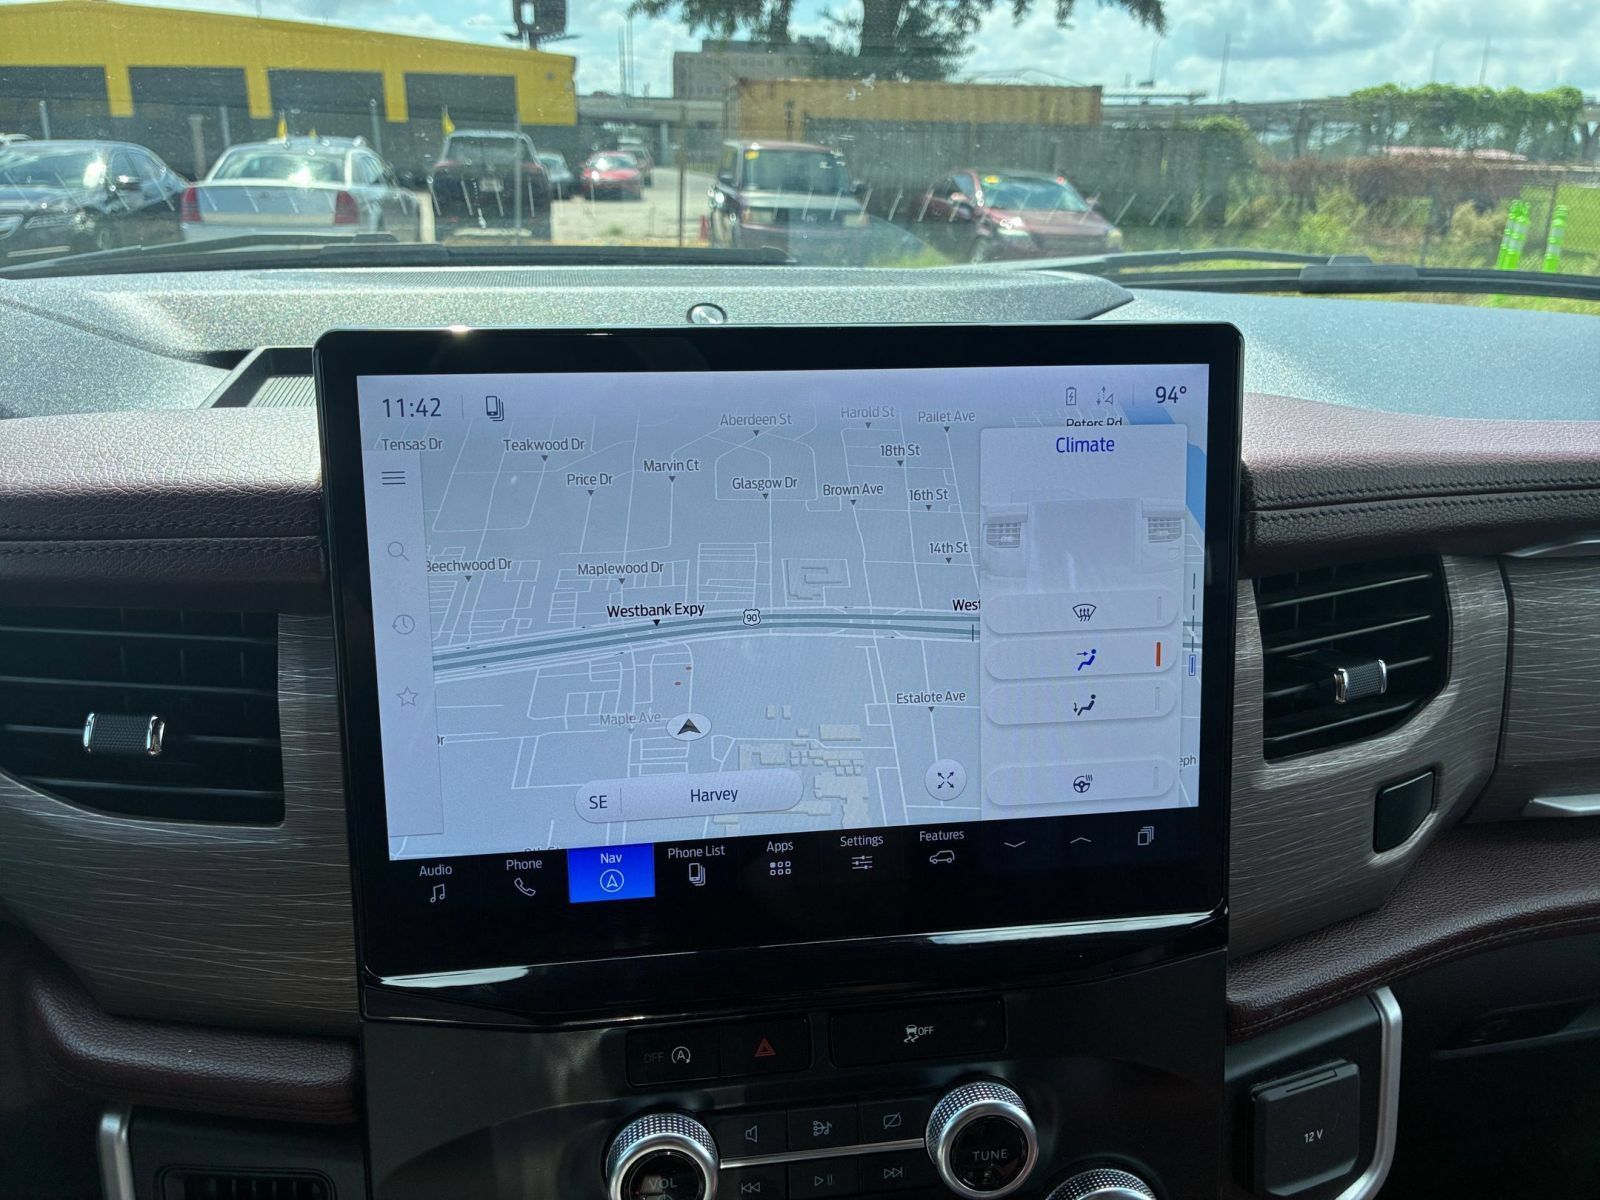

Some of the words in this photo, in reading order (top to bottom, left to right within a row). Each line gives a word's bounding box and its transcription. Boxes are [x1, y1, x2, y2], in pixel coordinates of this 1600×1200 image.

[381, 397, 442, 418] 11:42
[841, 406, 879, 419] Harold
[882, 406, 895, 418] St
[720, 412, 776, 426] Aberdeen
[779, 412, 792, 425] St
[918, 410, 951, 423] Pailet
[953, 410, 976, 422] Ave
[381, 438, 426, 451] Tensas
[428, 437, 443, 450] Dr
[503, 438, 568, 452] Teakwood
[571, 437, 585, 450] Dr
[880, 444, 904, 457] 18th
[907, 444, 920, 456] St
[1056, 437, 1115, 453] Climate
[643, 459, 683, 472] Marvin
[686, 459, 700, 471] Ct
[567, 473, 596, 486] Price
[599, 473, 613, 485] Dr
[732, 477, 782, 492] Glasgow
[784, 476, 798, 489] Dr
[823, 484, 859, 496] Brown
[861, 483, 884, 495] Ave
[909, 488, 933, 501] 16th
[935, 488, 949, 500] St
[929, 541, 953, 554] 14th
[955, 541, 969, 553] St
[426, 558, 496, 573] Beechwood
[498, 558, 512, 570] Dr
[577, 562, 649, 577] Maplewood
[650, 561, 665, 573] Dr
[606, 603, 671, 618] Westbank
[674, 603, 705, 618] Expy
[746, 613, 758, 622] 90
[896, 691, 943, 704] Estalote
[944, 690, 966, 703] Ave
[600, 713, 637, 727] Maple
[638, 711, 661, 724] Ave
[589, 794, 608, 810] SE
[690, 788, 739, 804] Harvey
[840, 835, 884, 847] Settings
[919, 830, 965, 842] Features
[668, 848, 703, 859] Phone
[705, 845, 726, 857] List
[766, 841, 794, 853] Apps
[506, 859, 543, 871] Phone
[600, 853, 623, 864] Nav
[419, 864, 453, 877] Audio
[917, 1024, 935, 1036] OFF
[1304, 1131, 1315, 1143] 12
[1316, 1129, 1324, 1140] V
[971, 1148, 1009, 1162] TUNE
[648, 1176, 678, 1191] VOL
